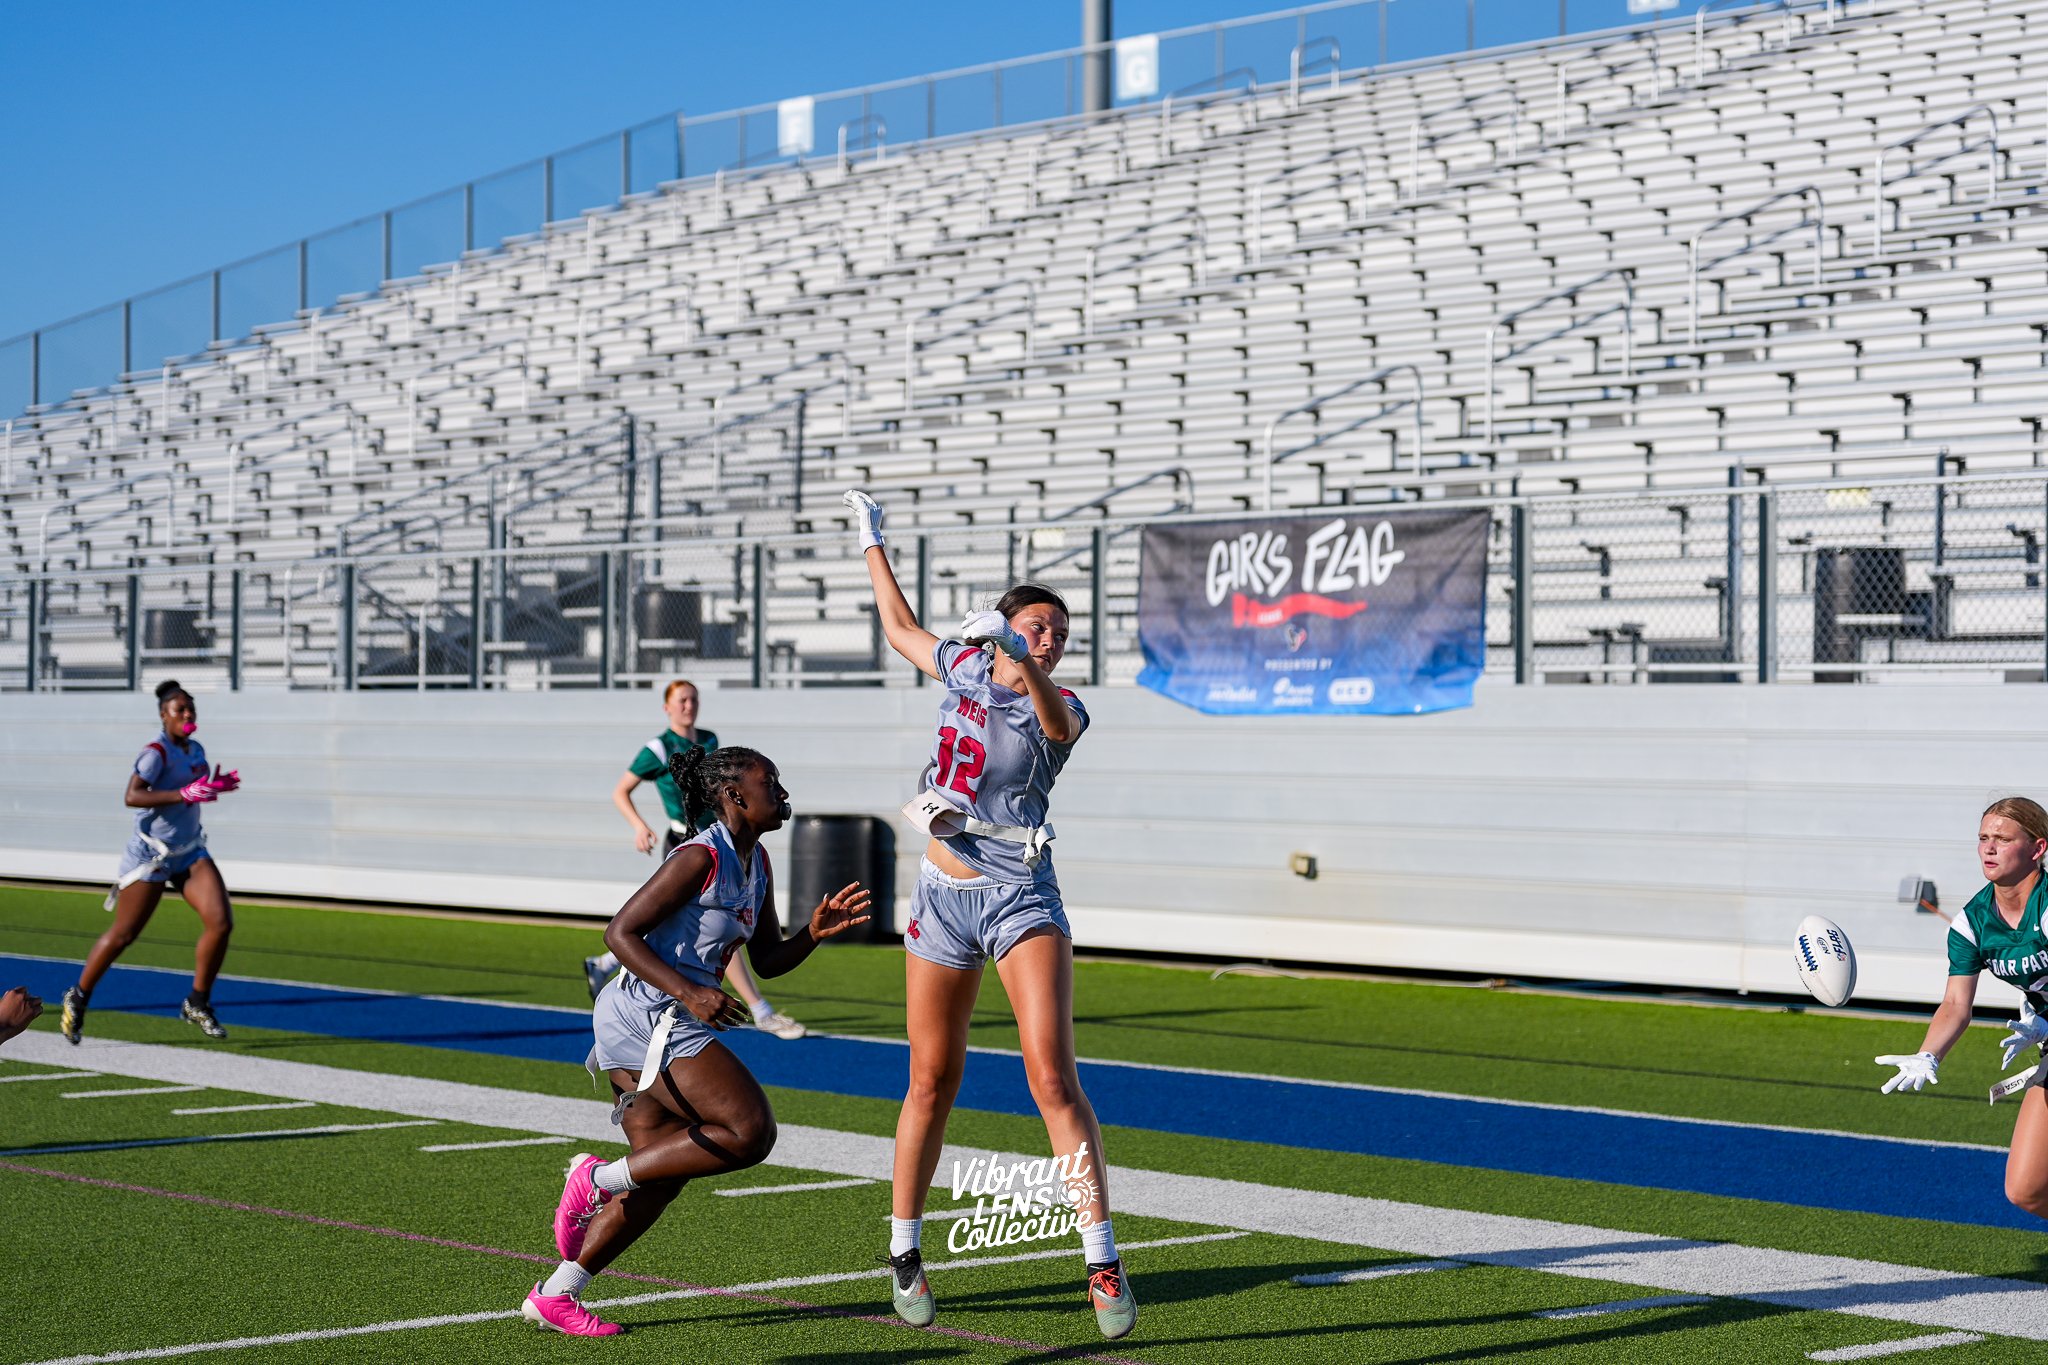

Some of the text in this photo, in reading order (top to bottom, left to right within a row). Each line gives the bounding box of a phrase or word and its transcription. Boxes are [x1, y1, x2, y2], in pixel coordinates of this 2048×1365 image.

[1126, 56, 1149, 89] G
[1206, 518, 1406, 607] GIRLS FLAG
[935, 725, 987, 805] 12
[2021, 949, 2048, 975] PAR
